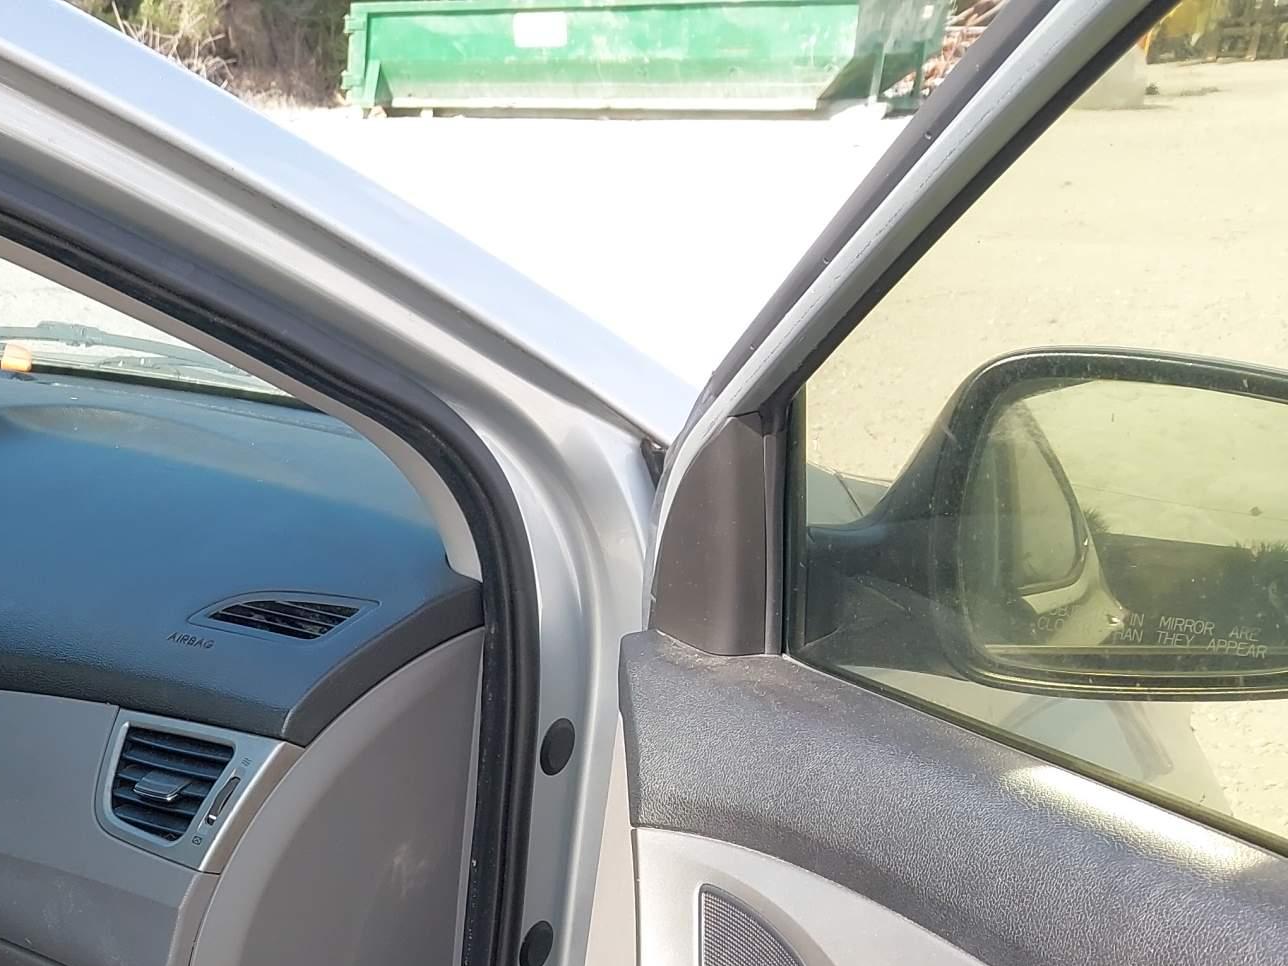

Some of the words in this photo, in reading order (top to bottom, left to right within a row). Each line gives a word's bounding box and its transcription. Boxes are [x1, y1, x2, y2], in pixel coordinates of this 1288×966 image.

[166, 632, 215, 649] AIRBAG
[1129, 613, 1145, 628] IN
[1159, 615, 1216, 636] MIRROR
[1229, 625, 1261, 642] ARE
[1156, 630, 1195, 648] THEY
[1206, 638, 1269, 659] APPEAR
